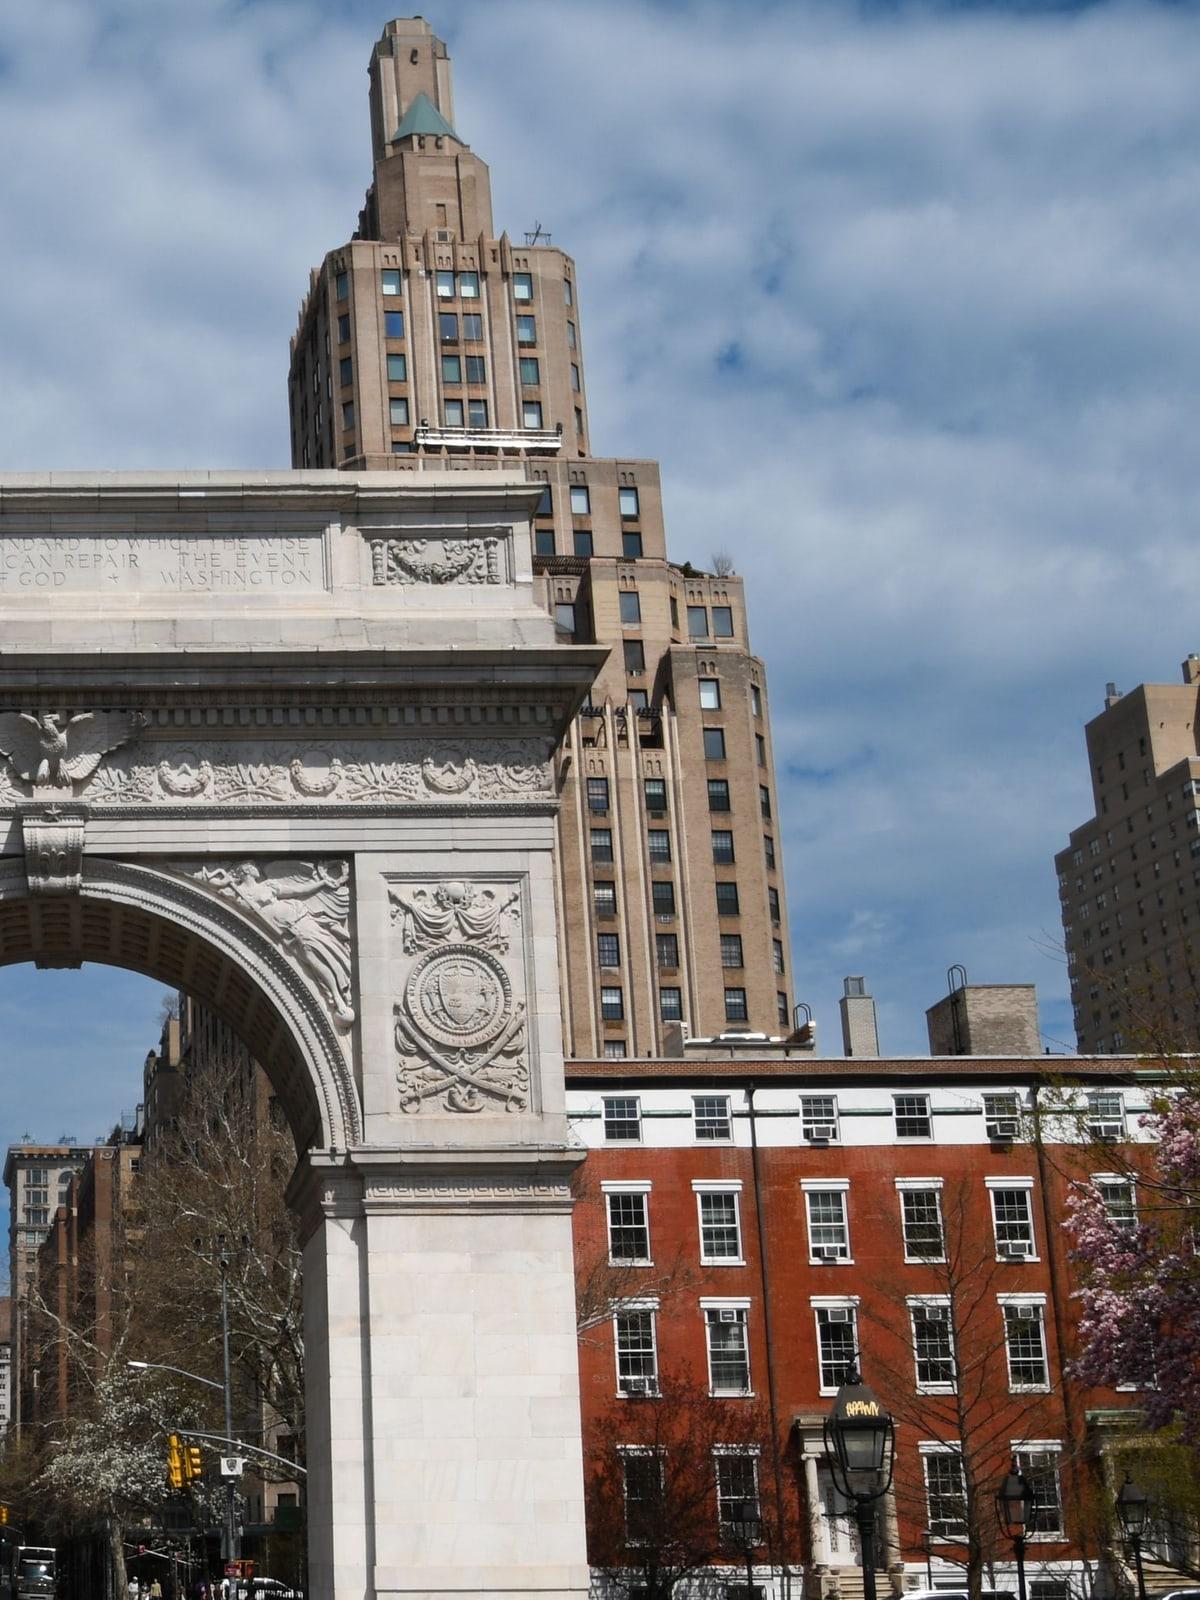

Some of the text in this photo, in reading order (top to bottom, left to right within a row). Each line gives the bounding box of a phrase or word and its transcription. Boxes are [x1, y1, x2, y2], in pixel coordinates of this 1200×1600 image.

[92, 536, 119, 551] TO
[126, 536, 199, 550] WHICH
[208, 535, 248, 550] THE
[258, 536, 310, 550] WISE
[5, 554, 52, 569] CAN
[64, 553, 140, 568] REPAIR
[177, 552, 221, 567] THE
[236, 552, 310, 567] EVENT
[19, 571, 66, 586] GOD
[160, 570, 311, 585] WASHINGTON
